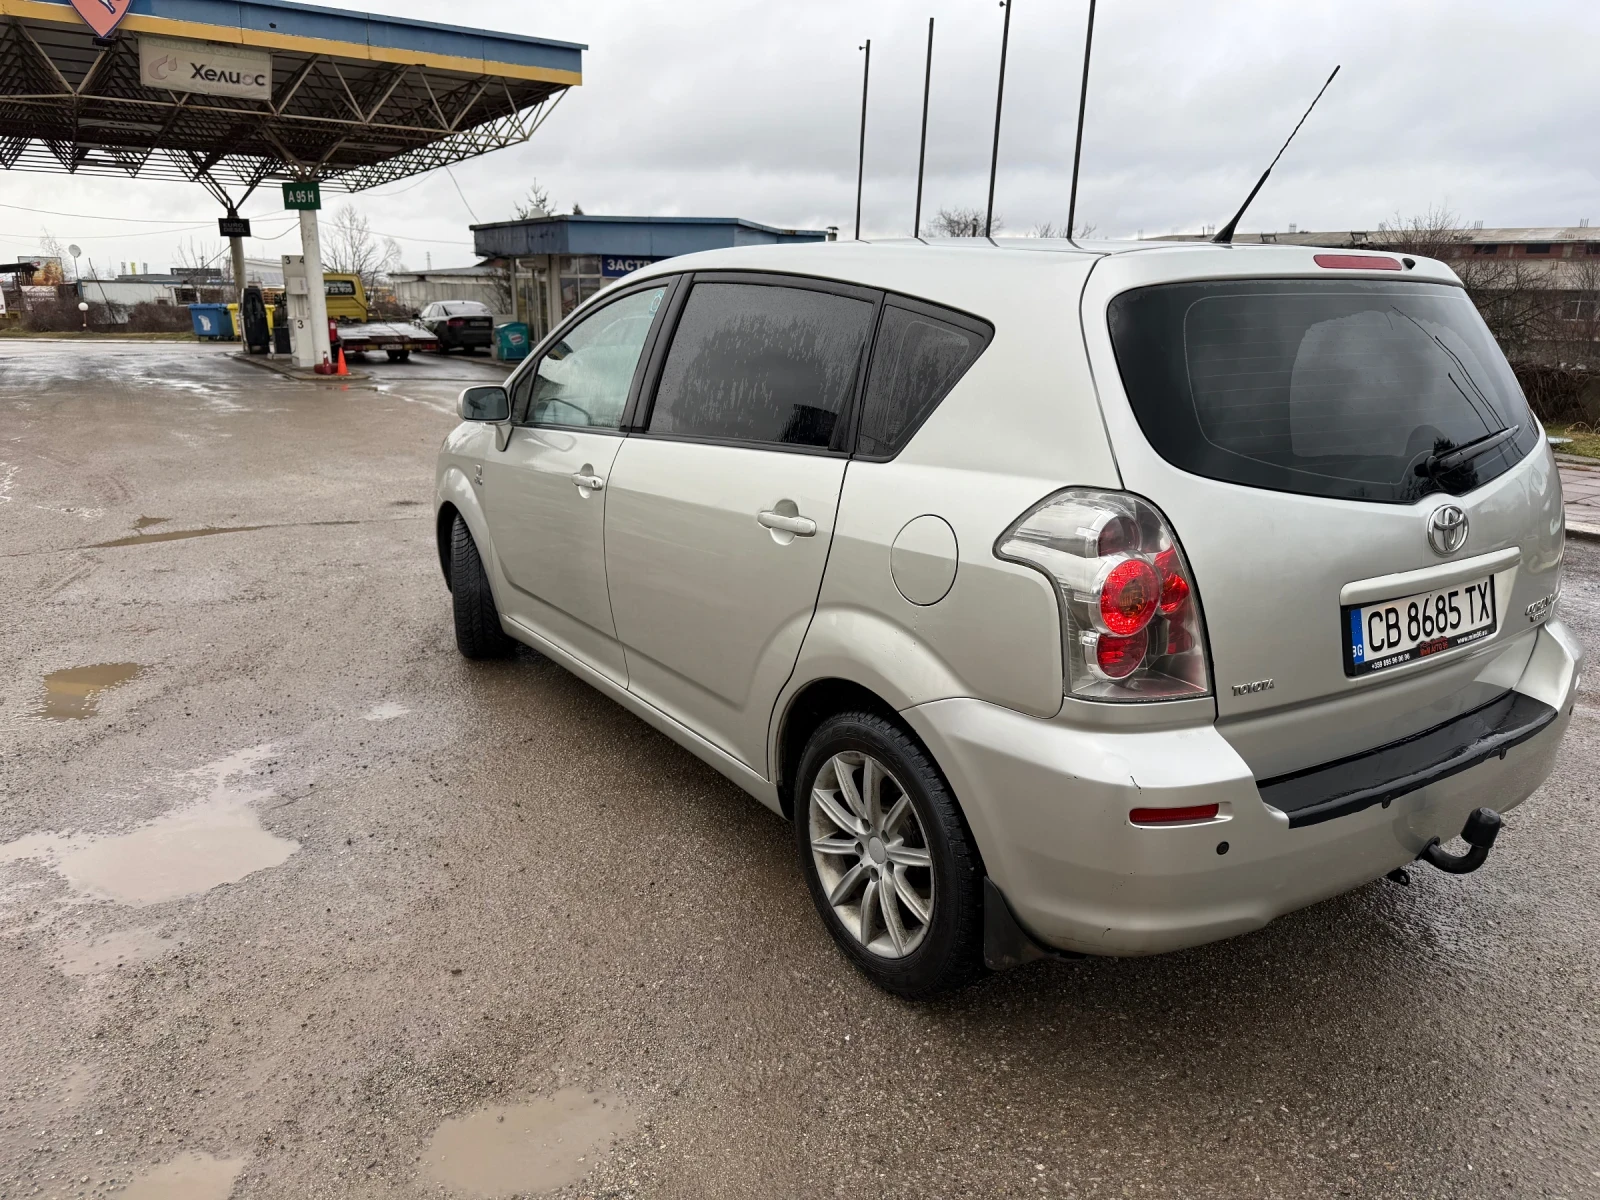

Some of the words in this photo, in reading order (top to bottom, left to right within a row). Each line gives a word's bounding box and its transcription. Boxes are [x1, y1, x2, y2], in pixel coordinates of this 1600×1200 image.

[190, 62, 266, 86] Хелиос
[288, 190, 295, 202] A
[296, 190, 306, 202] 95
[308, 191, 314, 202] H
[285, 256, 290, 264] 3
[300, 256, 304, 265] 4
[607, 258, 653, 271] ЗАСТР
[297, 320, 304, 329] 3
[1368, 607, 1401, 652] CB
[1408, 590, 1461, 641] 8685
[1465, 582, 1490, 624] TX
[1232, 678, 1274, 696] TOYOTA
